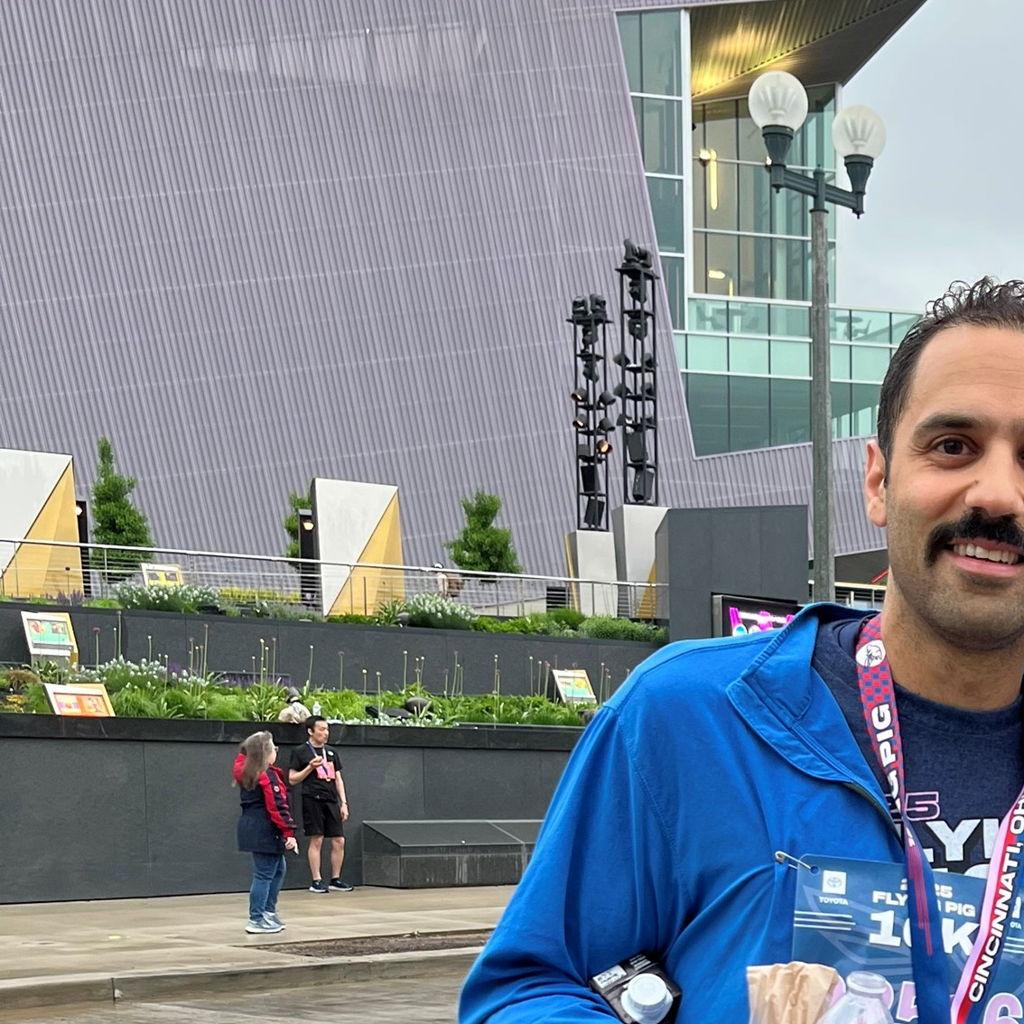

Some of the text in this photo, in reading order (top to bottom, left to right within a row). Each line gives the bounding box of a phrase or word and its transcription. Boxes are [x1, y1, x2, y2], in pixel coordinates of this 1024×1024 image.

[871, 703, 896, 768] PIG
[818, 895, 849, 906] TOYOTA
[945, 902, 976, 917] PIG
